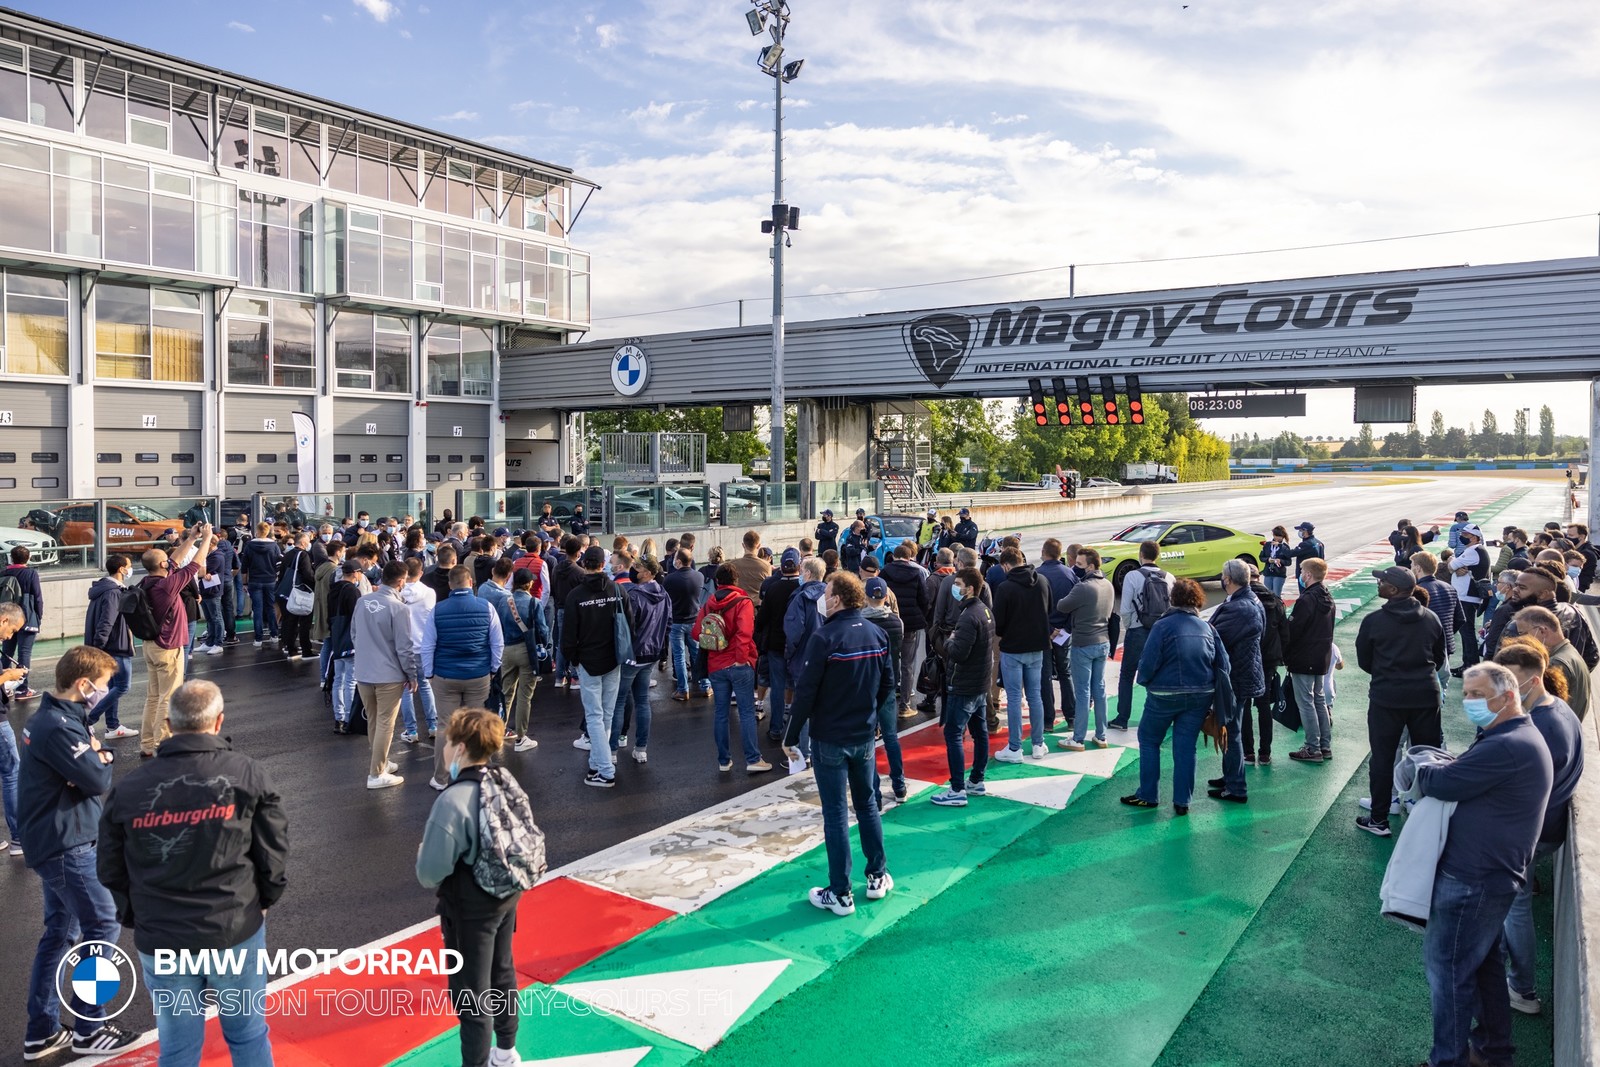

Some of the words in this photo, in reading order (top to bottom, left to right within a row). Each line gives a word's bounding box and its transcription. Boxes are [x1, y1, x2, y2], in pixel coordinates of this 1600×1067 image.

[982, 288, 1419, 351] Magny-Cours
[615, 346, 643, 361] BMW
[974, 358, 1123, 373] INTERNATIONAL
[1130, 354, 1216, 367] CIRCUIT
[1231, 350, 1307, 362] NEVERS
[1313, 346, 1397, 359] FRANCE
[1190, 399, 1243, 411] 08:23:08
[143, 416, 156, 427] 44
[264, 420, 275, 430] 45
[366, 424, 377, 434] 46
[109, 528, 135, 536] BMW
[1160, 550, 1185, 561] BMW
[132, 804, 236, 828] nürburgring
